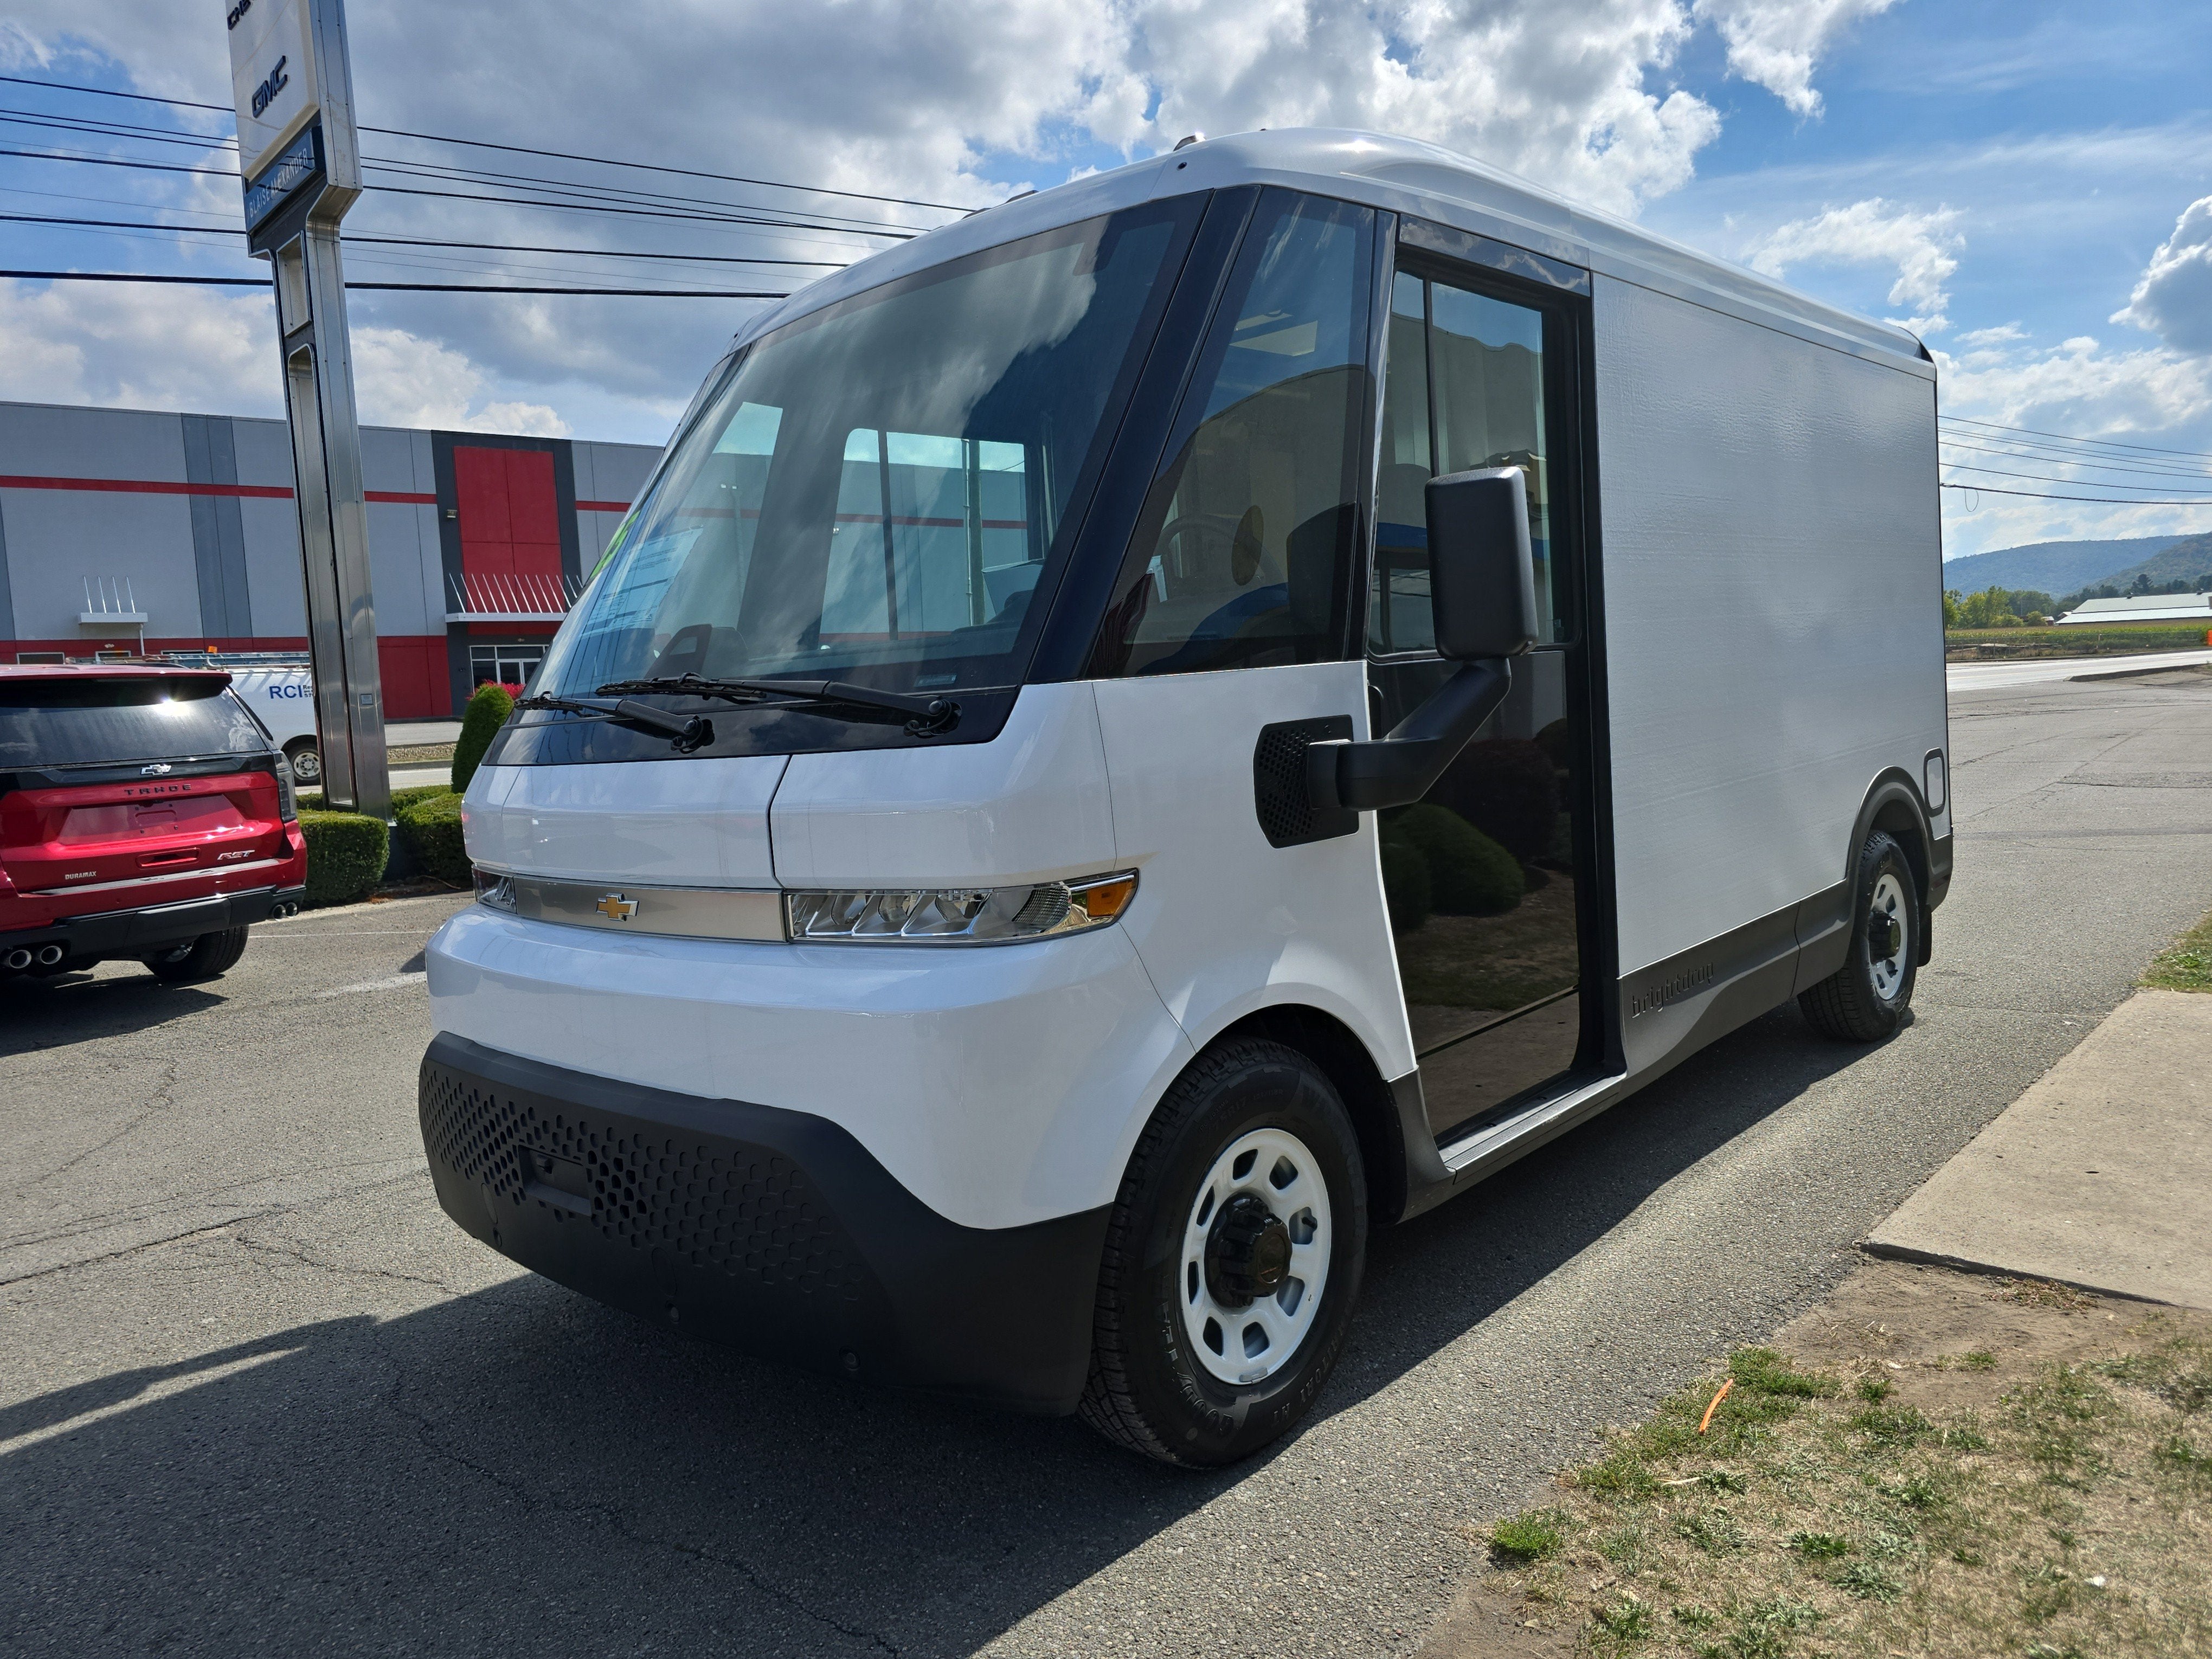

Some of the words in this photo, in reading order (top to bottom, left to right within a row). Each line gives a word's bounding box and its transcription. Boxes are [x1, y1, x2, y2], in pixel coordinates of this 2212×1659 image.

[251, 55, 288, 118] GMC
[249, 184, 271, 218] BLAISE
[271, 148, 308, 198] ALEXANDER
[269, 685, 303, 699] RCI
[124, 783, 191, 795] TAHOE
[217, 850, 255, 860] RST
[65, 871, 97, 880] DURAMAX
[1631, 962, 1714, 1018] brightdrop
